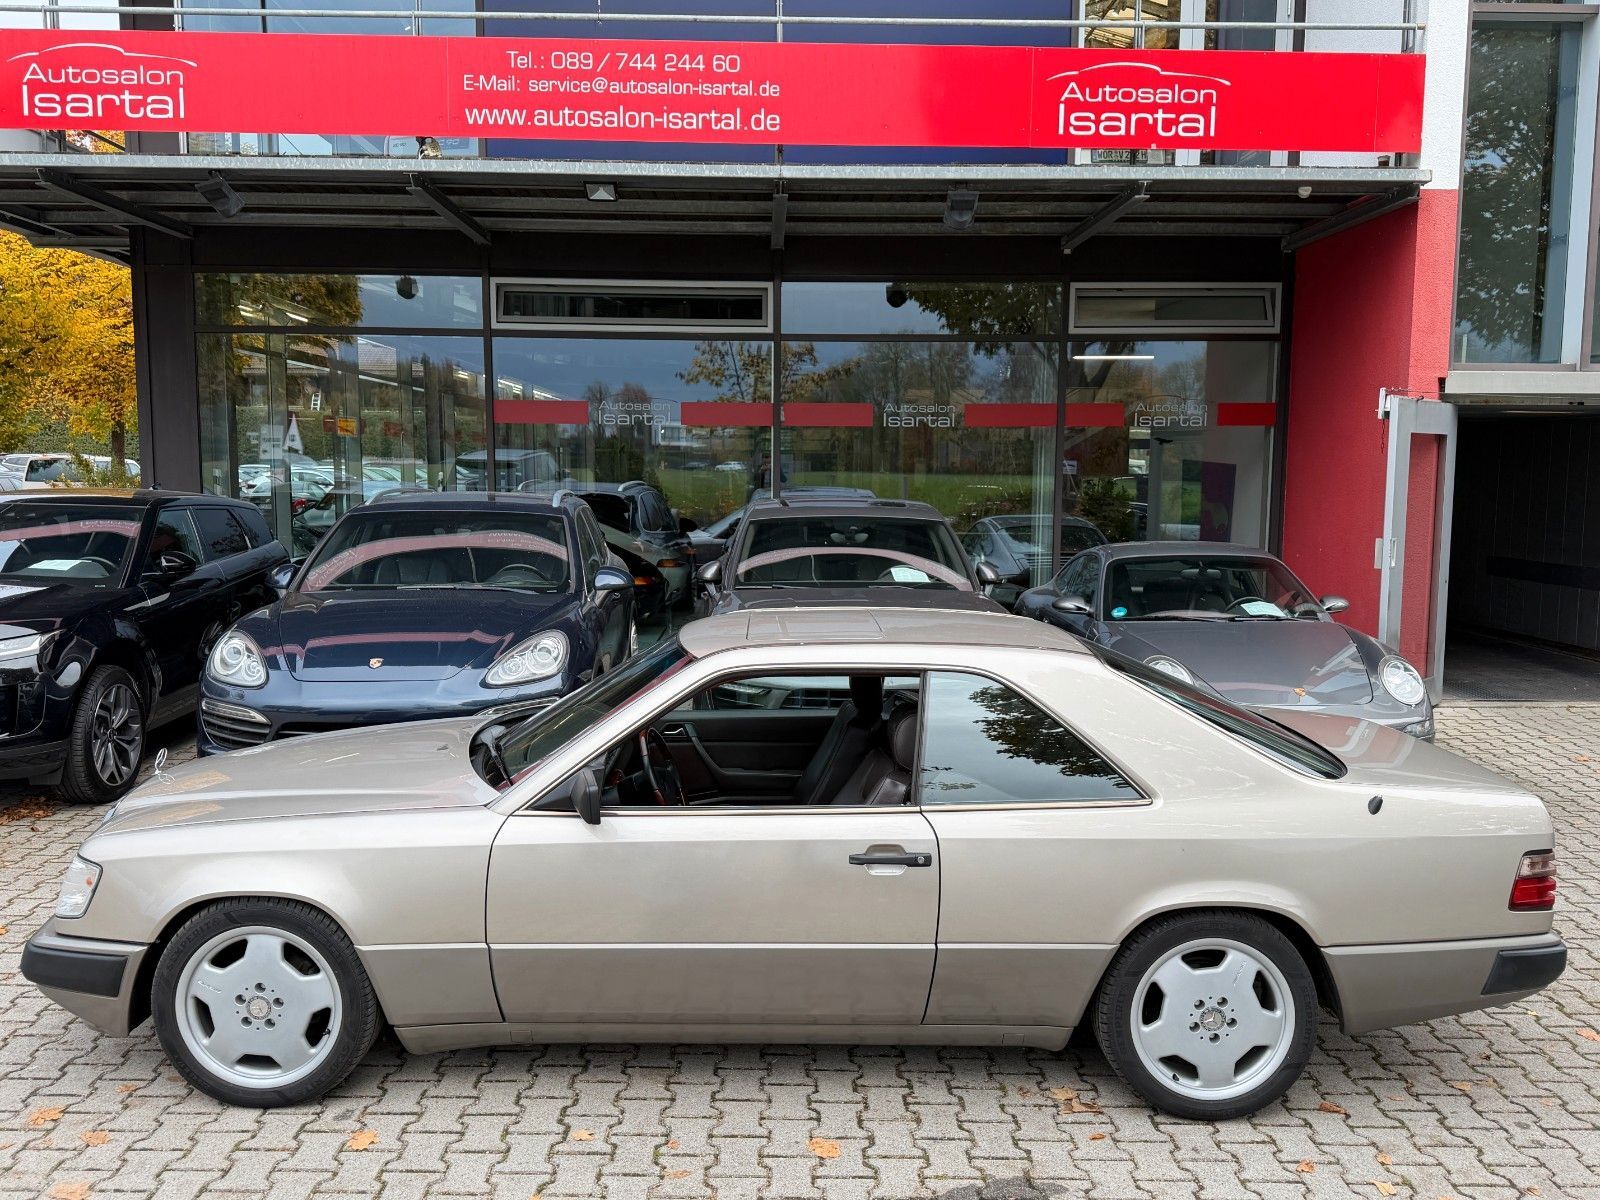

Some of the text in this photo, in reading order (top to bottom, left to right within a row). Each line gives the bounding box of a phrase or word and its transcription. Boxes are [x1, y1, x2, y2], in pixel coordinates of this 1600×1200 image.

[506, 51, 545, 69] Tel.:
[551, 51, 594, 70] 089
[615, 52, 657, 71] 744
[664, 53, 706, 72] 244
[712, 54, 741, 73] 60
[22, 63, 184, 86] Autosalon
[463, 74, 780, 97] E-Mail: service@autosalon-isartal.de
[22, 84, 185, 119] Isartal
[1060, 82, 1217, 104] Autosalon
[464, 106, 781, 132] www.autosalon-isartal.de
[1058, 103, 1216, 137] Isartal
[598, 400, 671, 411] Autosalon
[883, 402, 956, 413] Autosalon
[1135, 402, 1208, 412] Autosalon
[598, 410, 671, 426] Isartal
[883, 412, 955, 428] Isartal
[1134, 411, 1208, 427] Isartal
